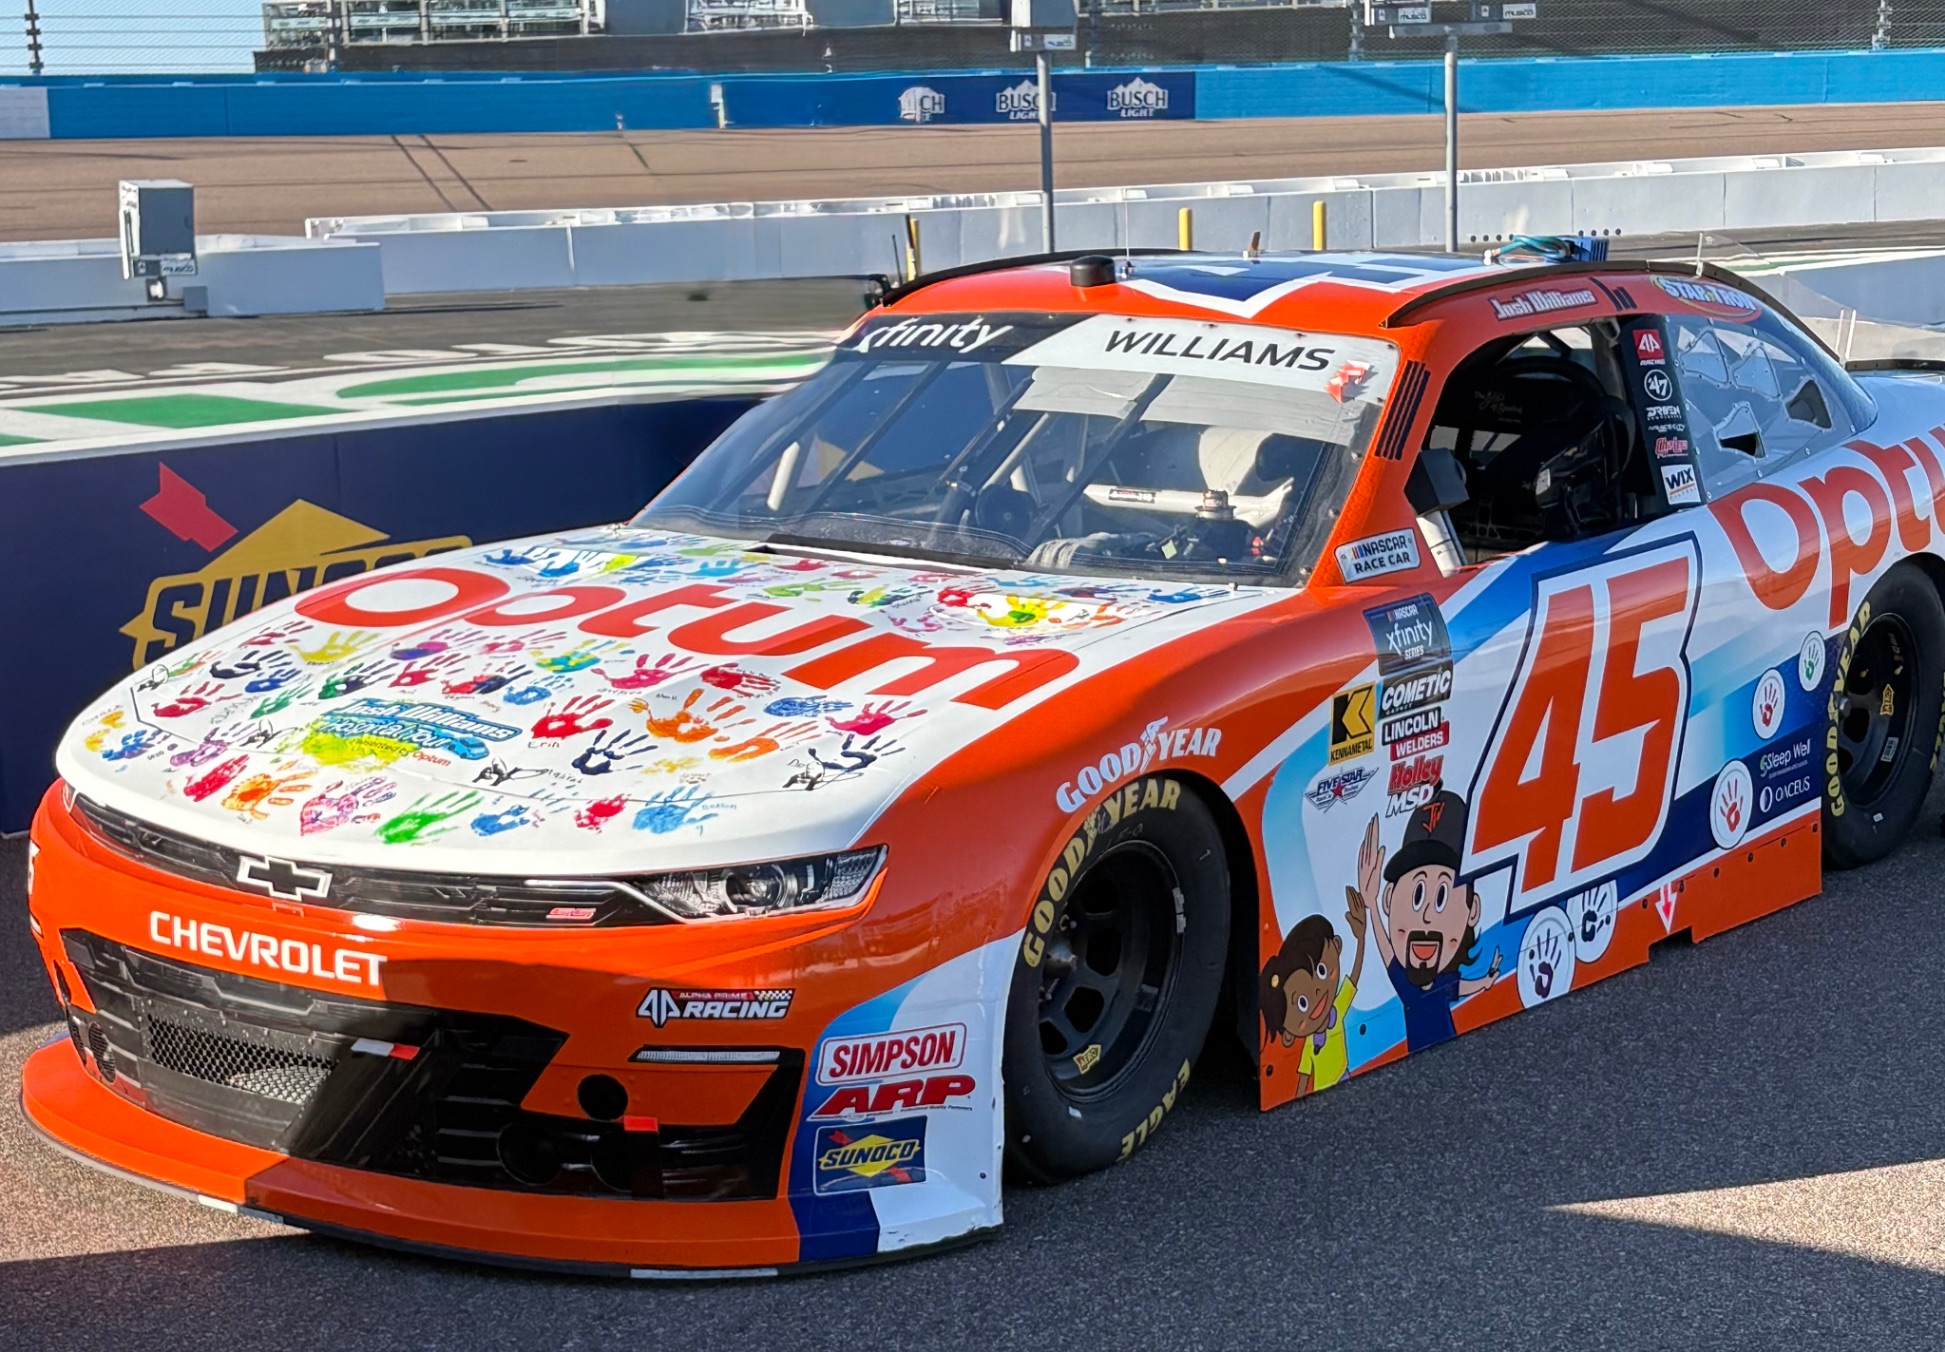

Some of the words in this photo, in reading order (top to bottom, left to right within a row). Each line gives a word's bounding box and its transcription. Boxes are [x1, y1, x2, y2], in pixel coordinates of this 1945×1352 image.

[999, 92, 1053, 110] BUSC
[1110, 90, 1165, 108] BUSCH
[1120, 108, 1154, 117] LIGHT
[1009, 110, 1039, 120] LIGH
[1490, 294, 1531, 318] Josh
[1529, 289, 1596, 311] Williams
[1105, 330, 1335, 372] WILLIAMS
[1665, 467, 1694, 490] WIX
[1363, 535, 1408, 556] NASCAR
[1354, 556, 1386, 574] RACE
[1389, 551, 1411, 566] CAR
[1393, 603, 1419, 620] NASCAR
[294, 567, 1081, 711] Optum
[1386, 619, 1433, 656] xfinity
[1404, 645, 1425, 660] SERIES
[1381, 670, 1451, 711] COMETIC
[341, 701, 397, 717] Josh
[401, 703, 515, 740] Williams
[1384, 710, 1439, 743] LINCOLN
[1468, 554, 1691, 896] 45
[1330, 739, 1373, 763] KENNAMETAL
[1395, 731, 1444, 758] WELDERS
[413, 751, 452, 767] Optum
[1056, 726, 1222, 814] GOODYEAR
[1767, 749, 1792, 770] Sleep
[1317, 777, 1339, 795] FIVE
[1341, 769, 1363, 784] STAR
[1388, 755, 1444, 796] Holley
[1385, 782, 1435, 818] MSD
[1023, 778, 1182, 968] GOODYEAR
[150, 910, 388, 987] CHEVROLET
[682, 1001, 790, 1019] RACING
[829, 1030, 956, 1078] SIMPSON
[1079, 1049, 1099, 1069] AERO
[814, 1075, 976, 1116] ARP
[823, 1141, 917, 1168] SUNOCO
